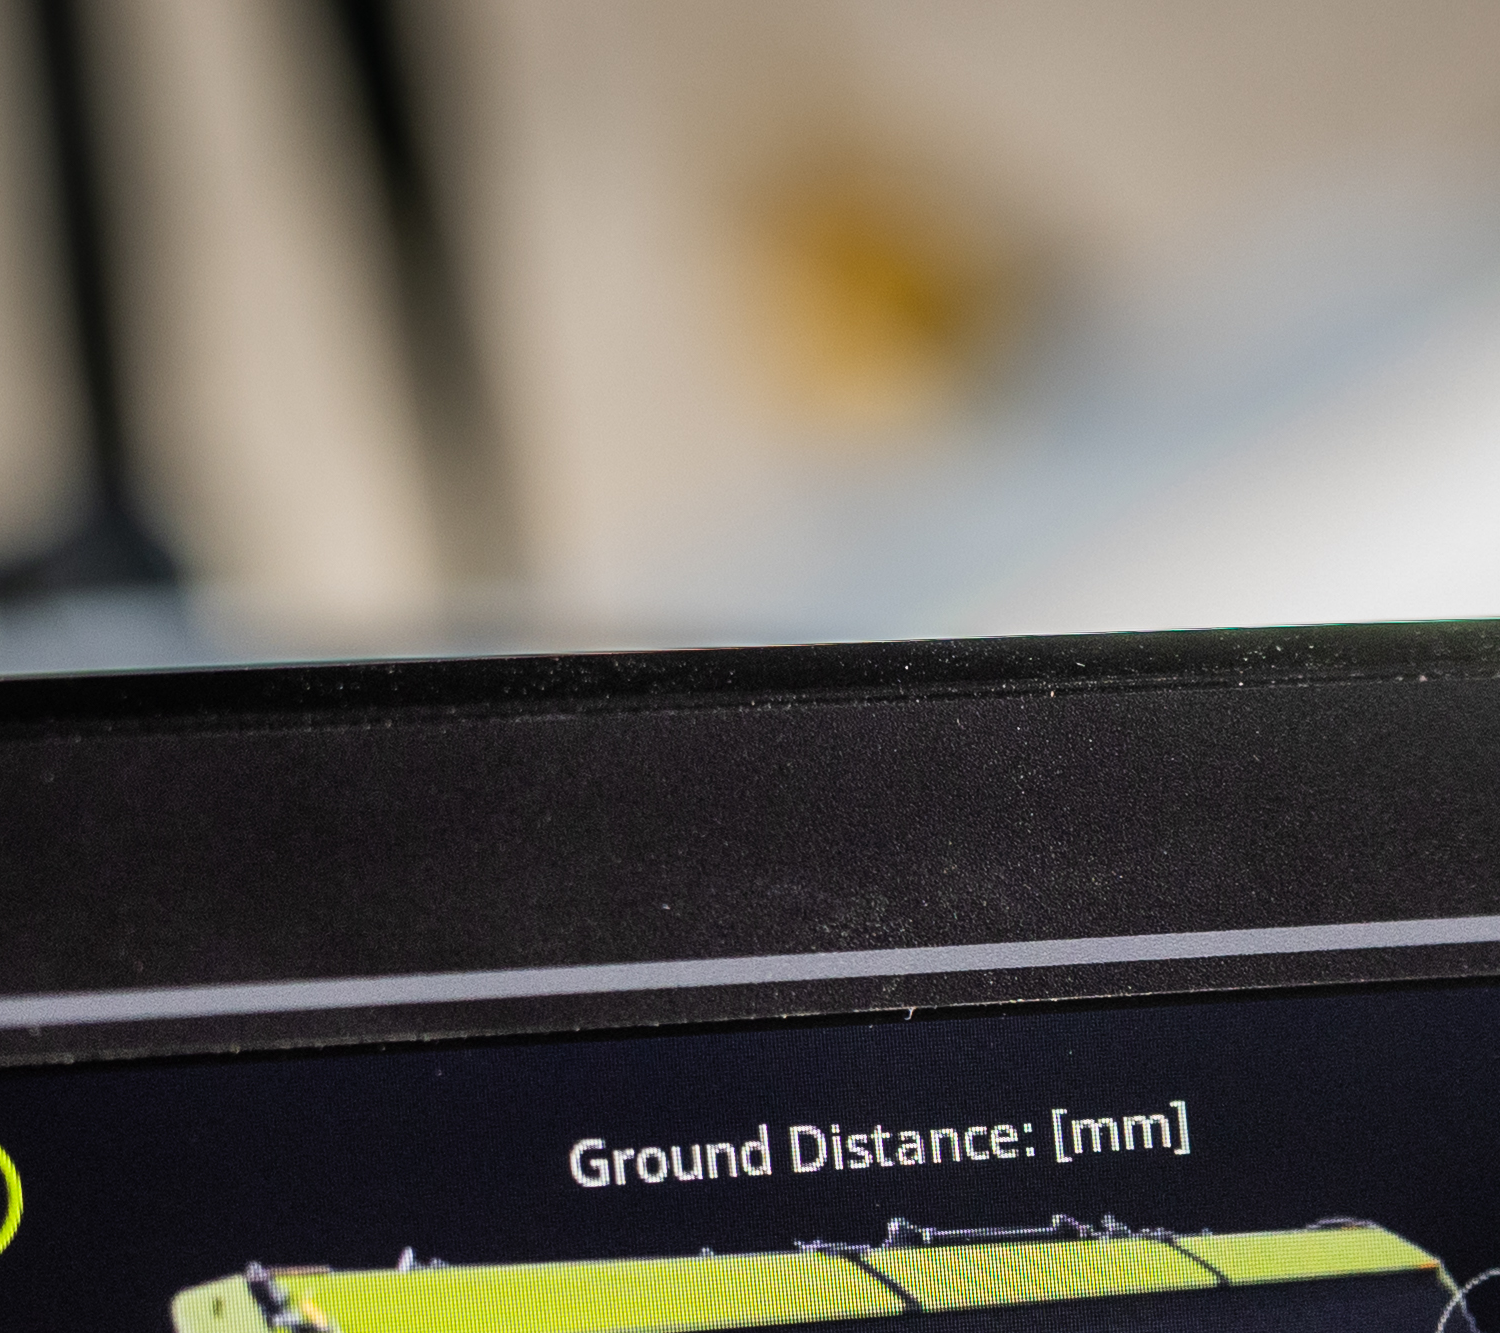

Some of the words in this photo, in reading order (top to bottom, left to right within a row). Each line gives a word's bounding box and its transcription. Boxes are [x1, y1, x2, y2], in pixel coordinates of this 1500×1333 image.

[568, 1123, 774, 1189] Ground
[788, 1122, 1036, 1174] Distance:
[1050, 1099, 1192, 1165] [mm]
